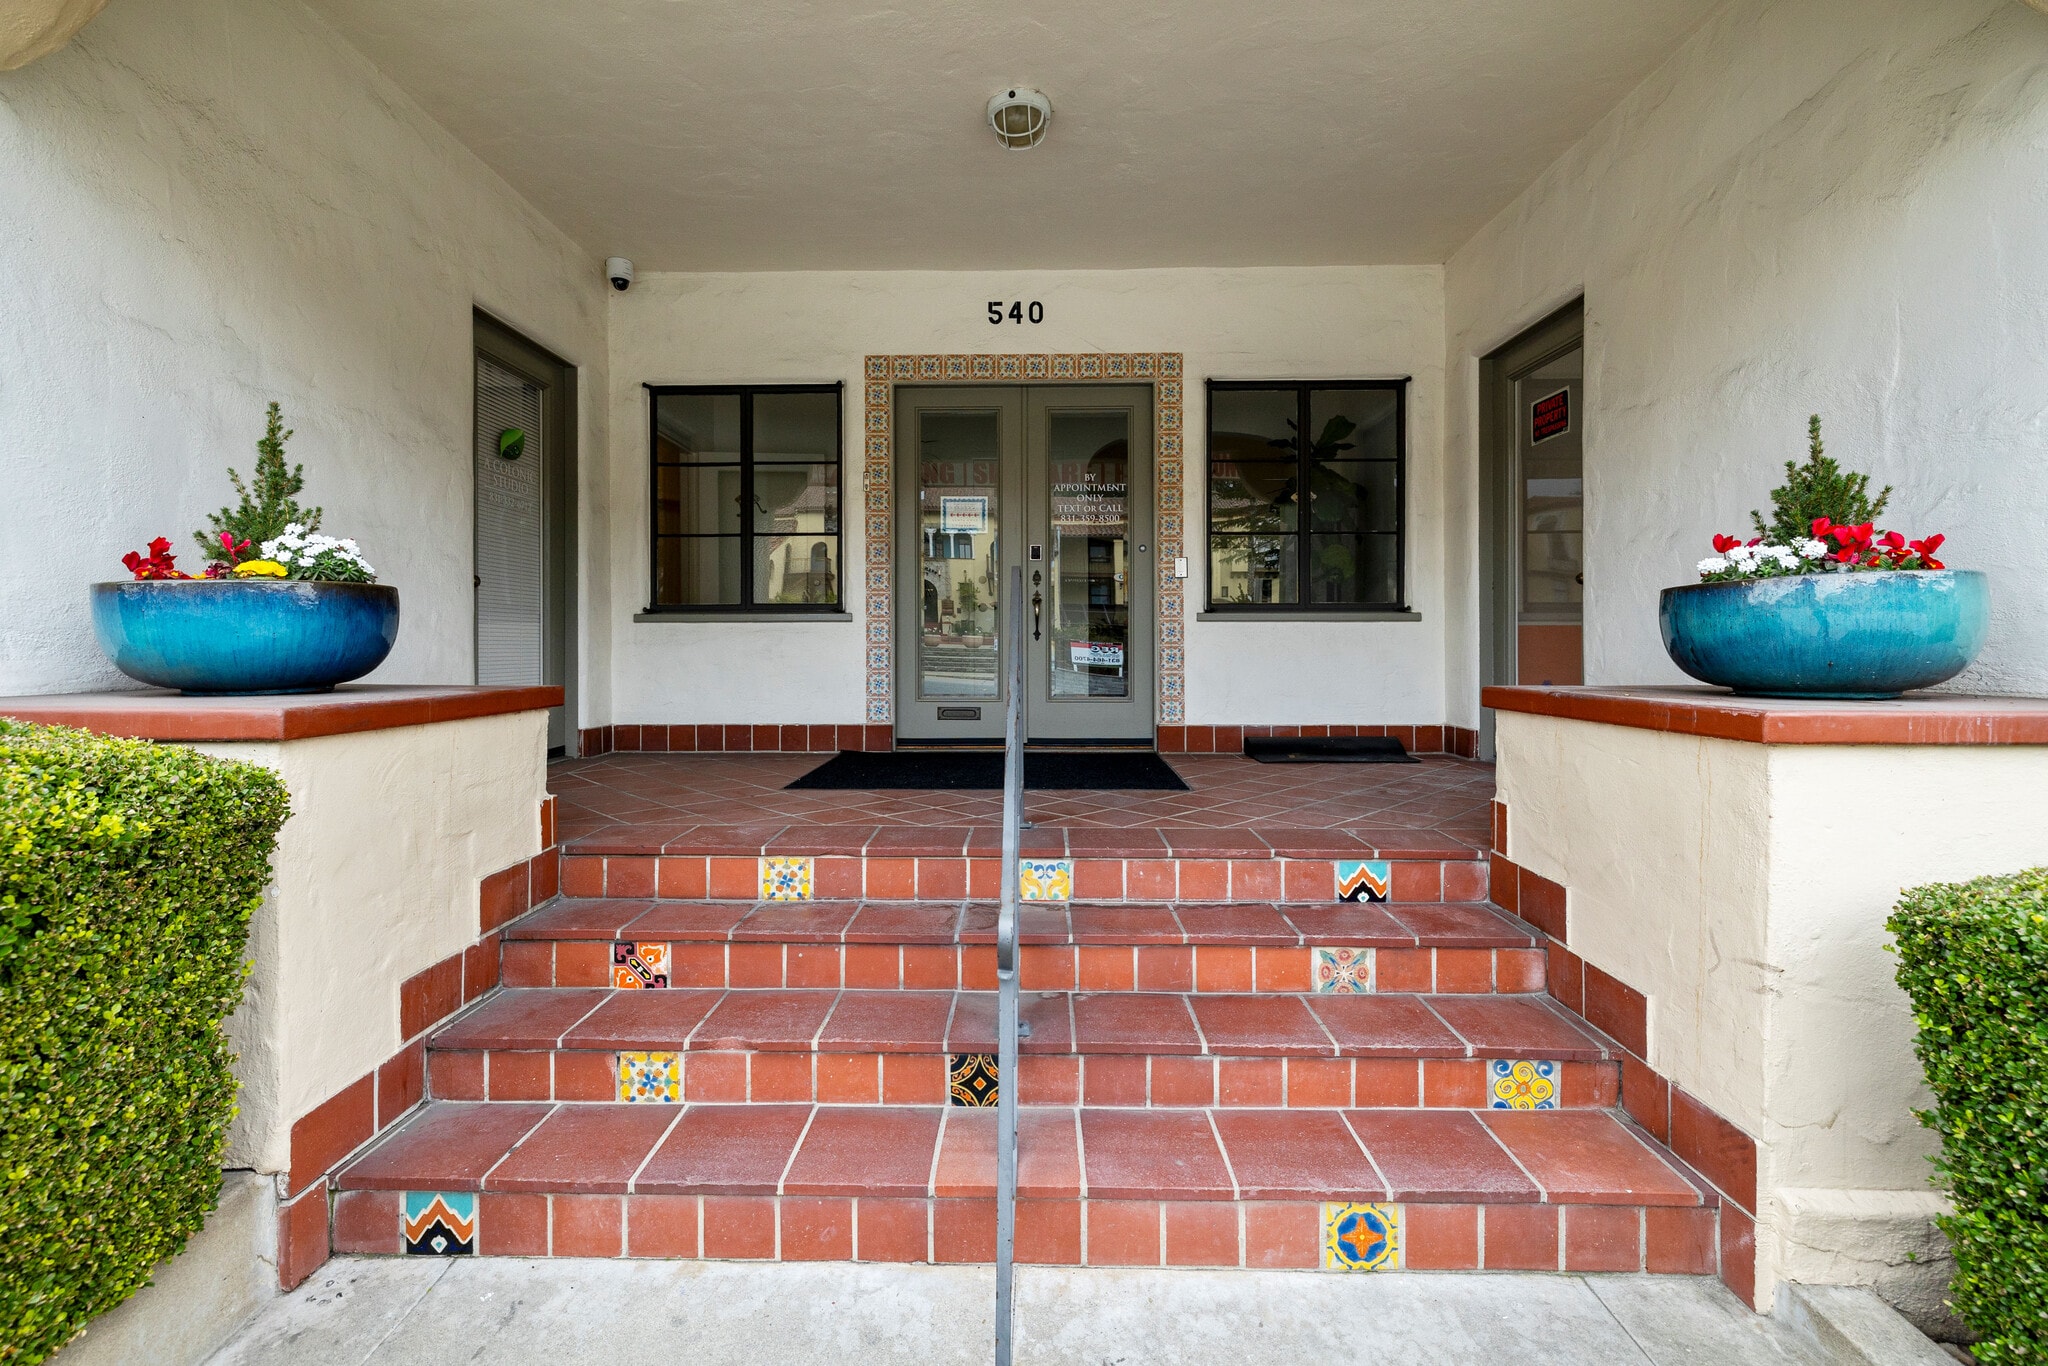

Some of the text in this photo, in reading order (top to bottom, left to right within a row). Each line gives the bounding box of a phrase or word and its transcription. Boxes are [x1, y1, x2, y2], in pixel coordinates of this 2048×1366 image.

[987, 301, 1043, 325] 540
[1536, 393, 1564, 415] PRIVATE
[1534, 406, 1567, 429] PROPERTY
[493, 460, 537, 484] COLONIC
[1084, 473, 1096, 482] BY
[493, 474, 529, 495] STUDIO
[1053, 483, 1127, 492] APPOINTMENT
[1076, 494, 1104, 502] ONLY
[1057, 504, 1082, 513] TEXT
[1099, 504, 1123, 512] CALL
[1060, 514, 1120, 523] 831-359-8500
